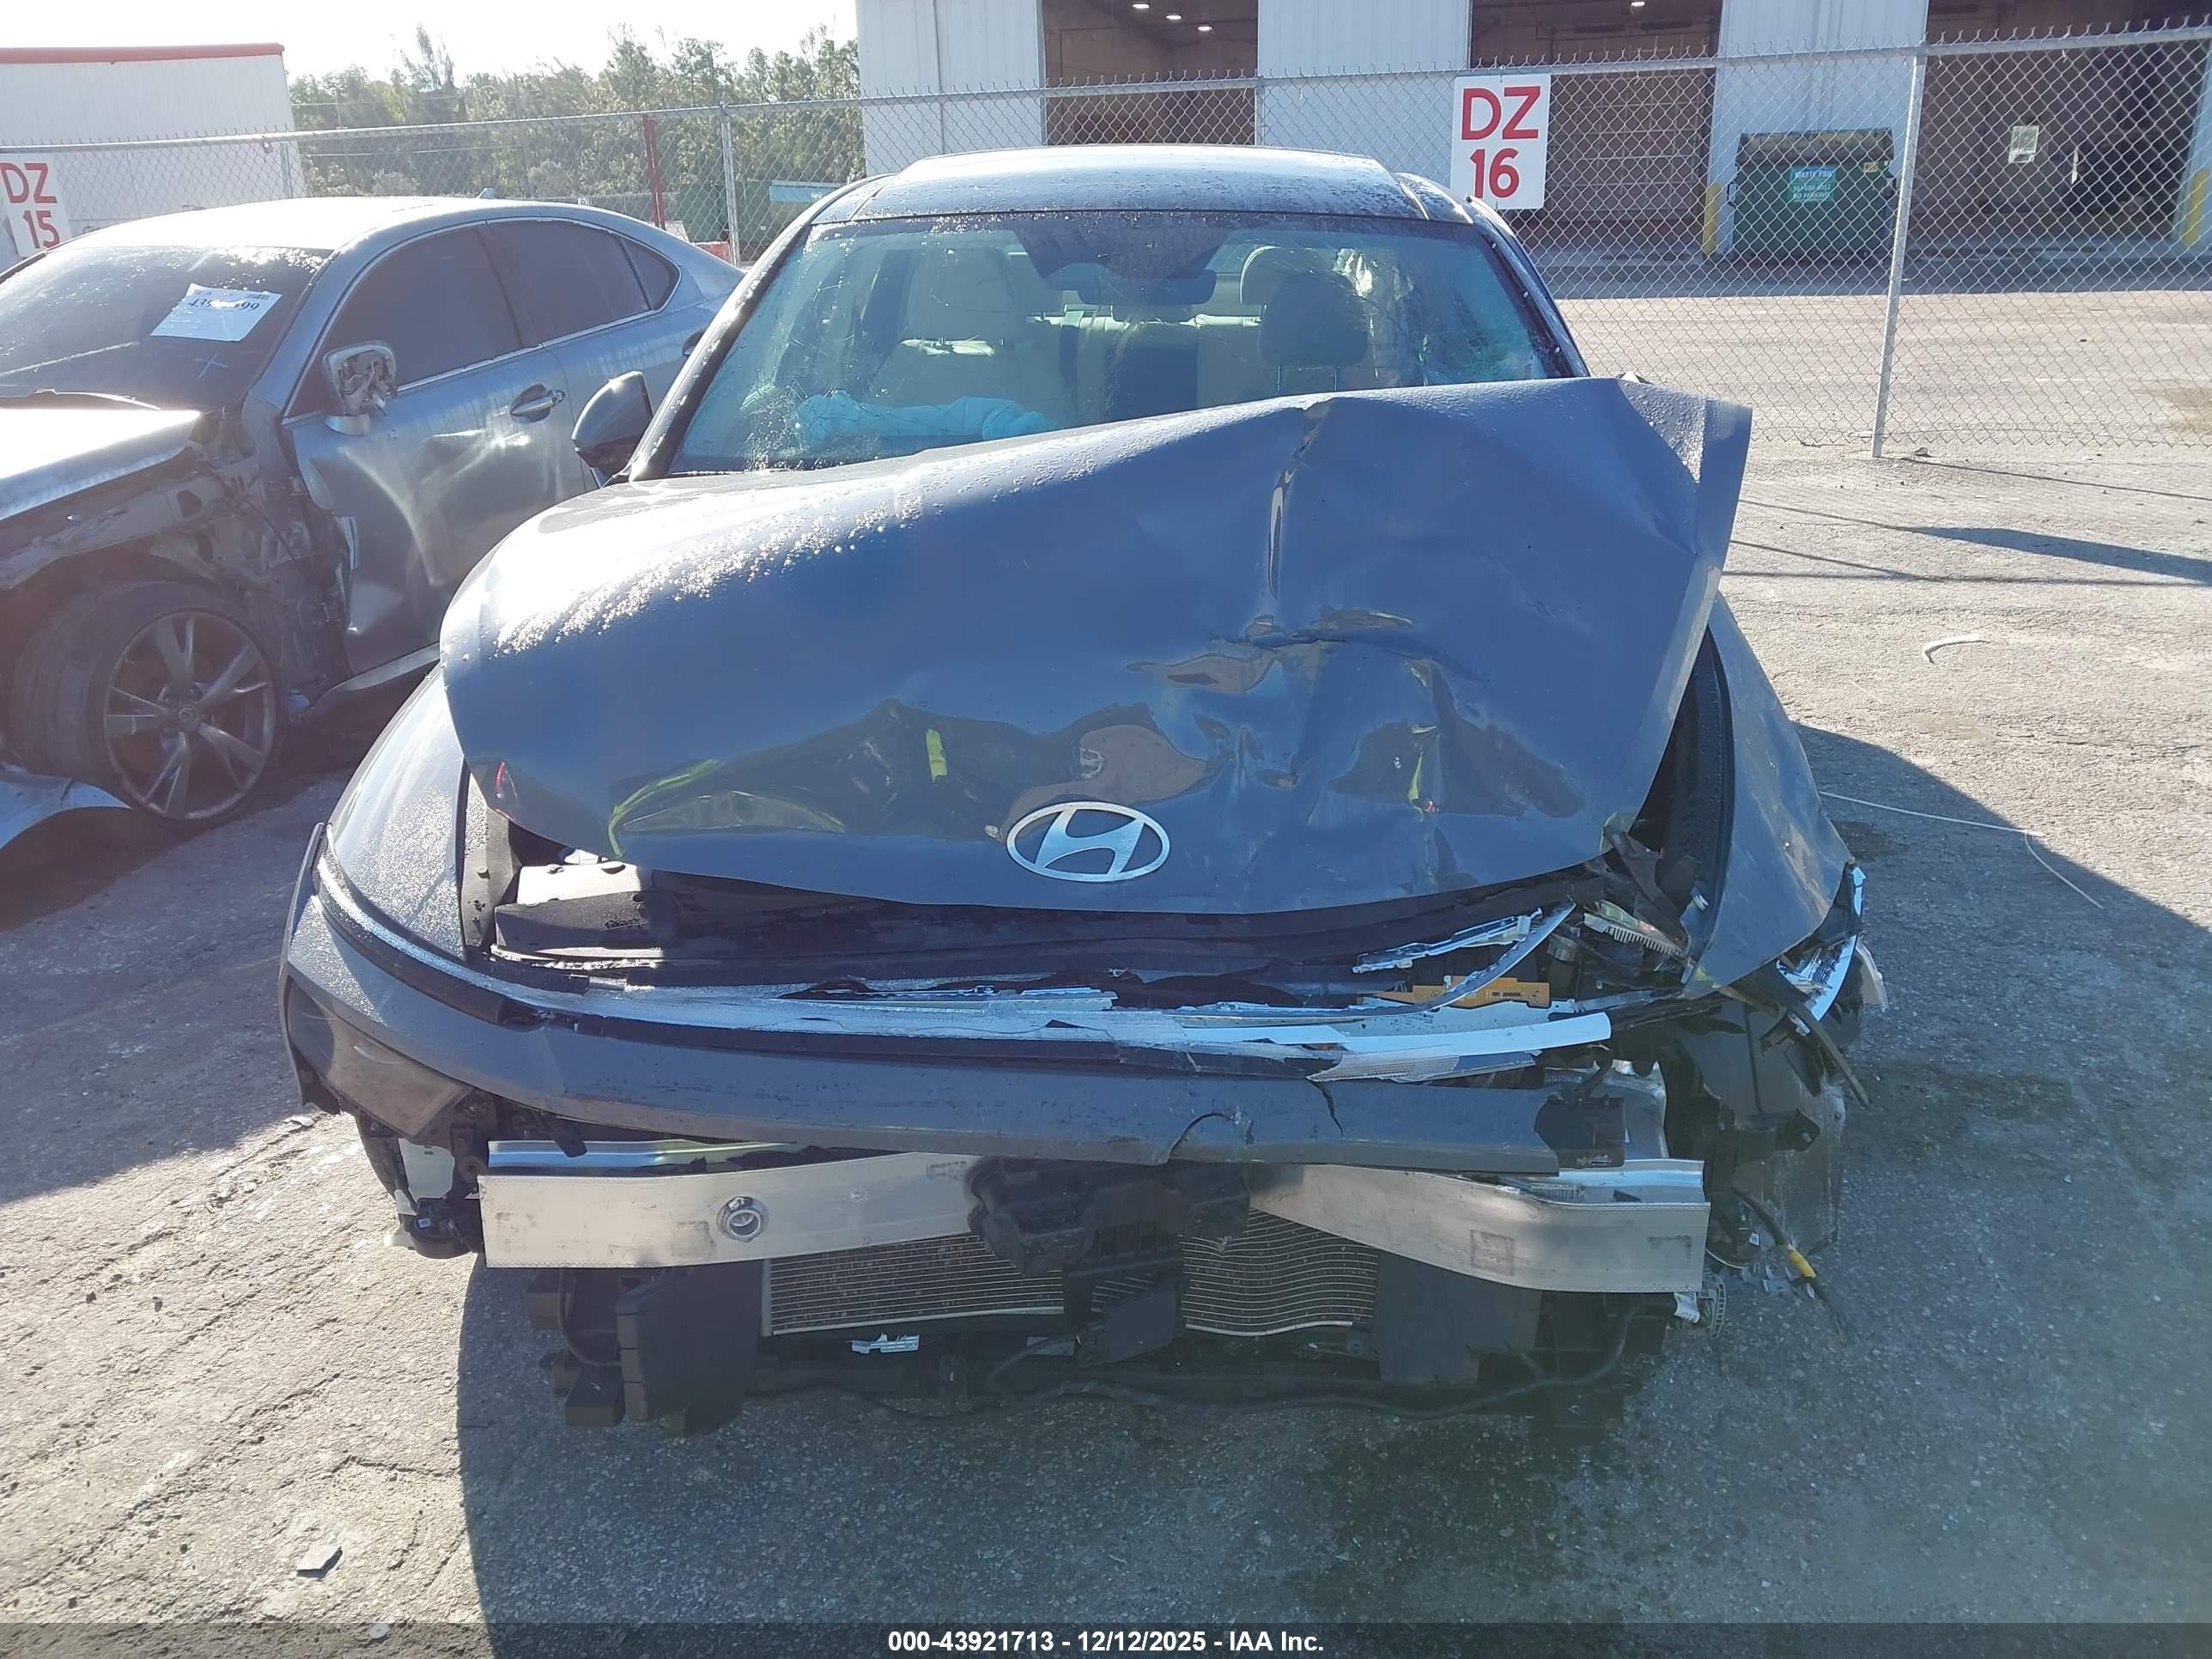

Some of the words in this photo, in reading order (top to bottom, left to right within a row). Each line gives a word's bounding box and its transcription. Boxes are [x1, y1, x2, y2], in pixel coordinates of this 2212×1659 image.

[1462, 86, 1541, 141] DZ
[0, 162, 58, 204] DZ
[1470, 148, 1520, 199] 16
[23, 210, 60, 249] 15
[187, 298, 260, 311] 43599
